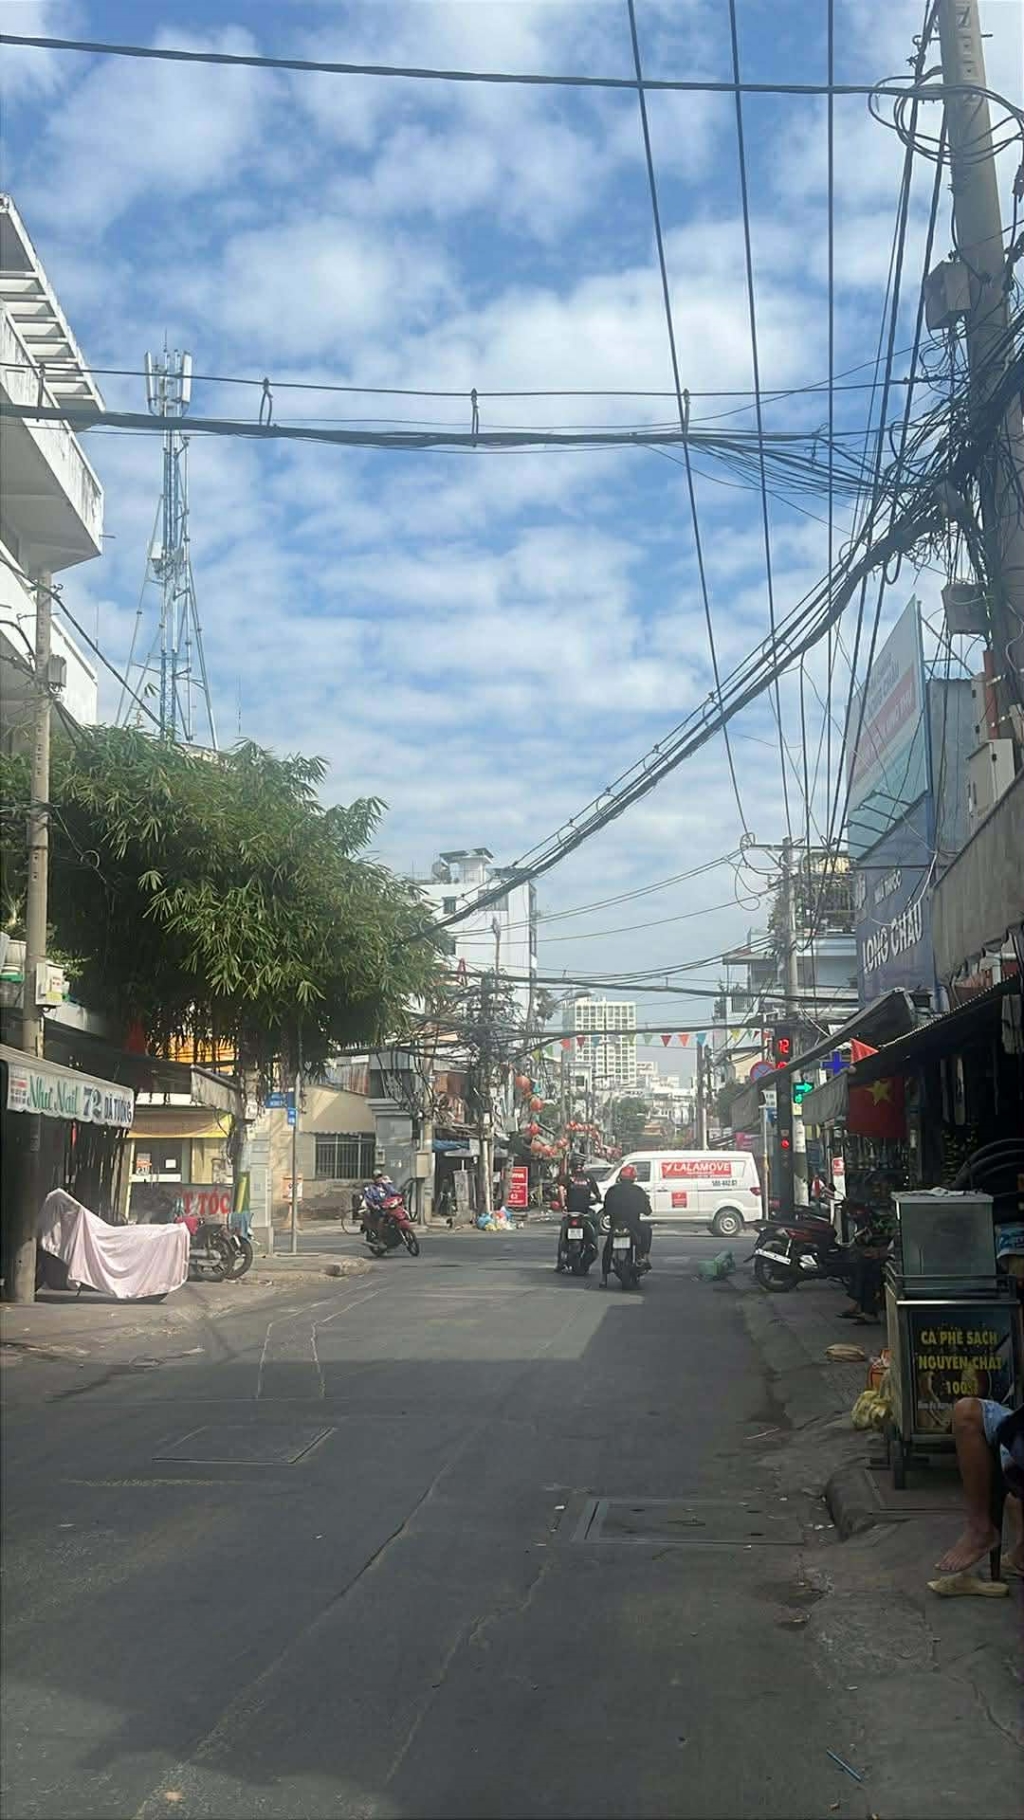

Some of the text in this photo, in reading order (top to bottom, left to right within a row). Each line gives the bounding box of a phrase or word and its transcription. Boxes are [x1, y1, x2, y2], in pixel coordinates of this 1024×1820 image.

[862, 926, 889, 974] LONG
[674, 1162, 730, 1172] LALAMOVE
[198, 1184, 230, 1214] TÓC
